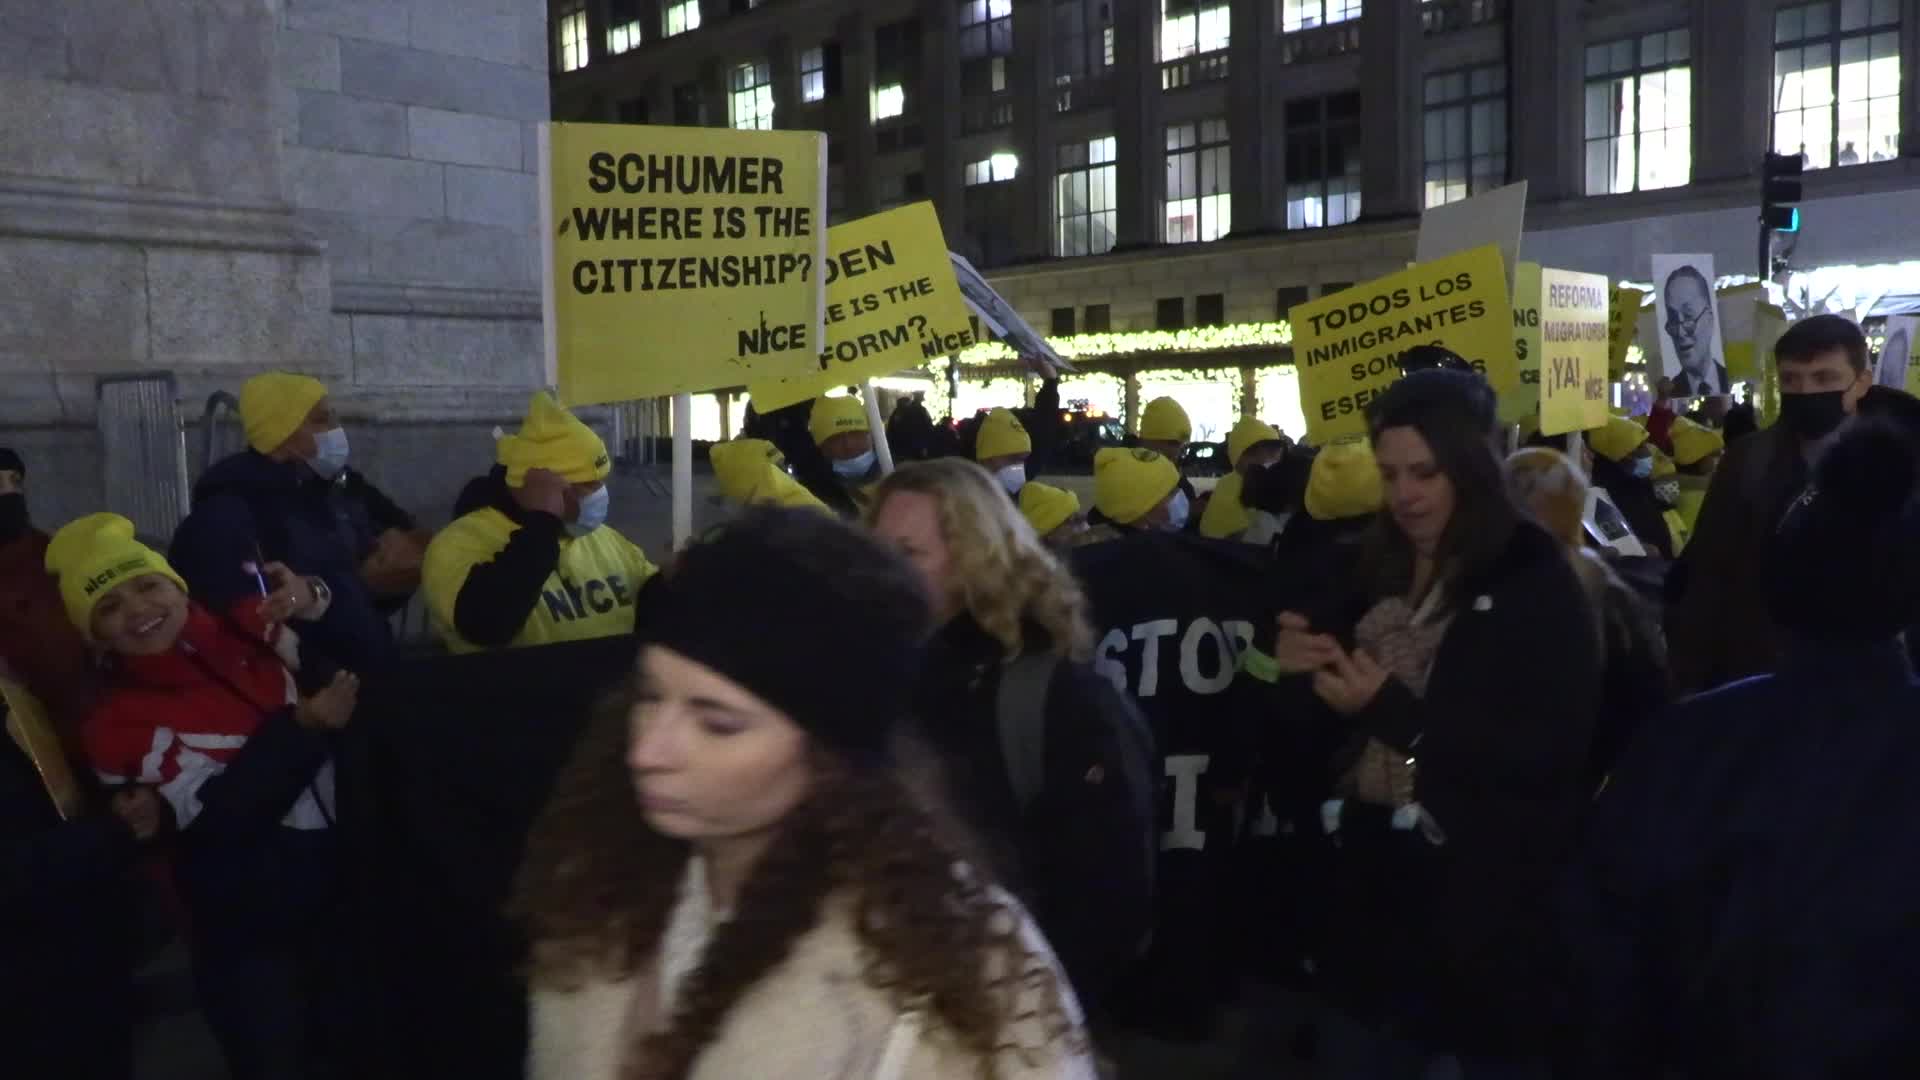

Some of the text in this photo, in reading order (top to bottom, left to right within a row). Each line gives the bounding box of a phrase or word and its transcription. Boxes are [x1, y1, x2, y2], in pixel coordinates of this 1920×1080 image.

[588, 152, 784, 194] SCHUMER
[572, 206, 811, 241] WHERE IS THE
[572, 253, 812, 294] CITIZENSHIP?
[850, 293, 880, 316] IS
[883, 277, 935, 304] THE
[1307, 272, 1473, 336] TODOS LOS
[737, 311, 806, 356] NICE
[1306, 300, 1486, 367] INMIGRANTES
[1547, 356, 1581, 399] ¡YA!
[542, 576, 634, 623] NICE
